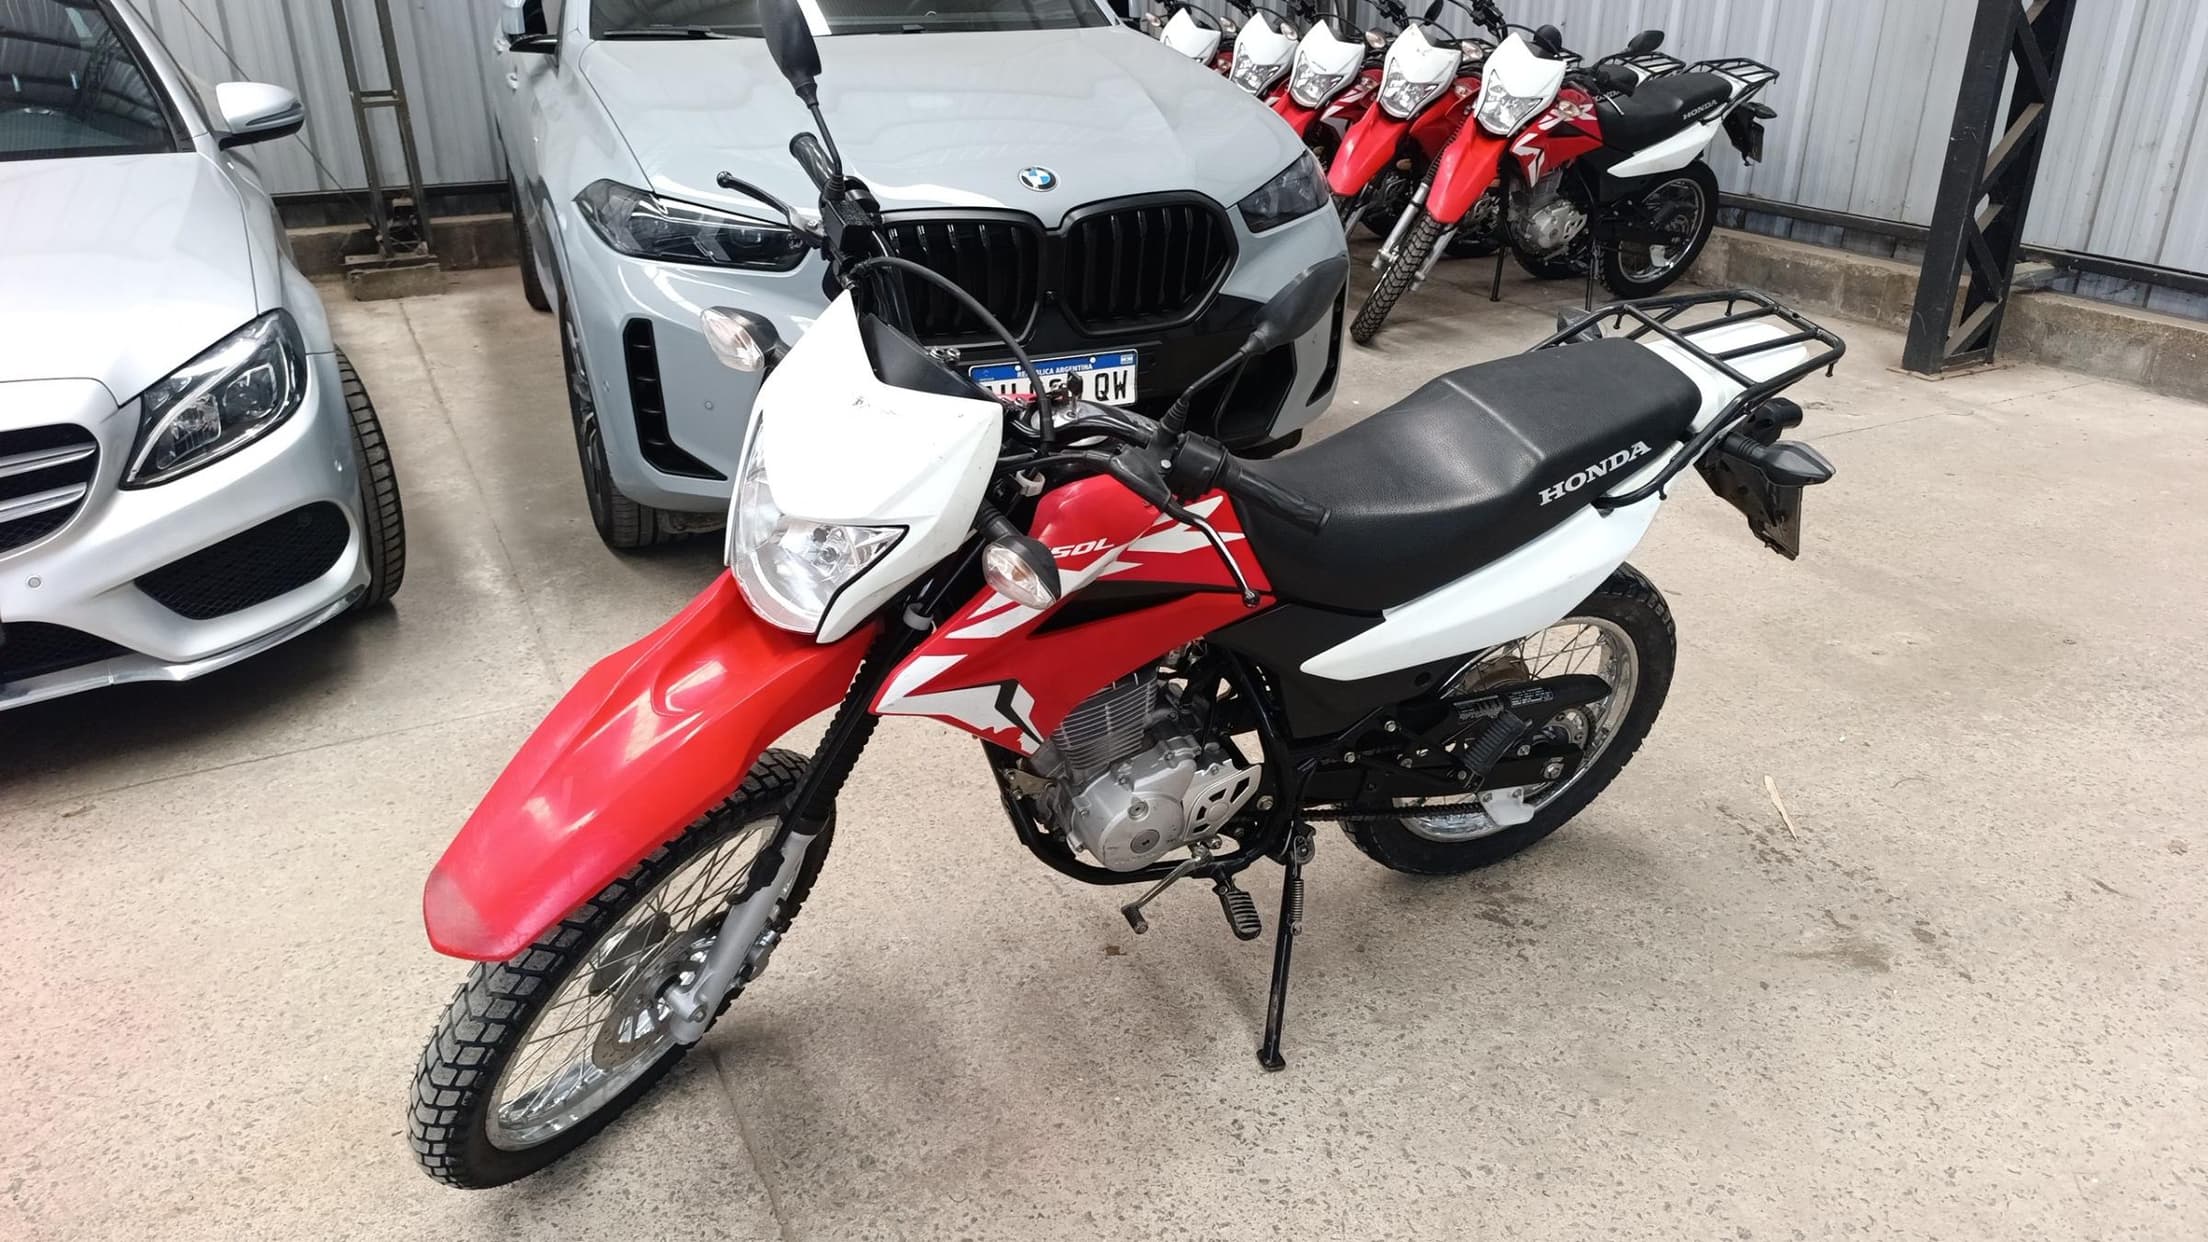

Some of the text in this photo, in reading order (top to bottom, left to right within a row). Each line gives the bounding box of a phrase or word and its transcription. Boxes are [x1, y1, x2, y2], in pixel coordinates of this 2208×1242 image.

[1683, 100, 1718, 120] HONDA
[1055, 363, 1093, 374] ARGENTINA
[1095, 370, 1128, 401] QW
[1538, 440, 1652, 506] HONDA
[1049, 537, 1115, 559] 50L
